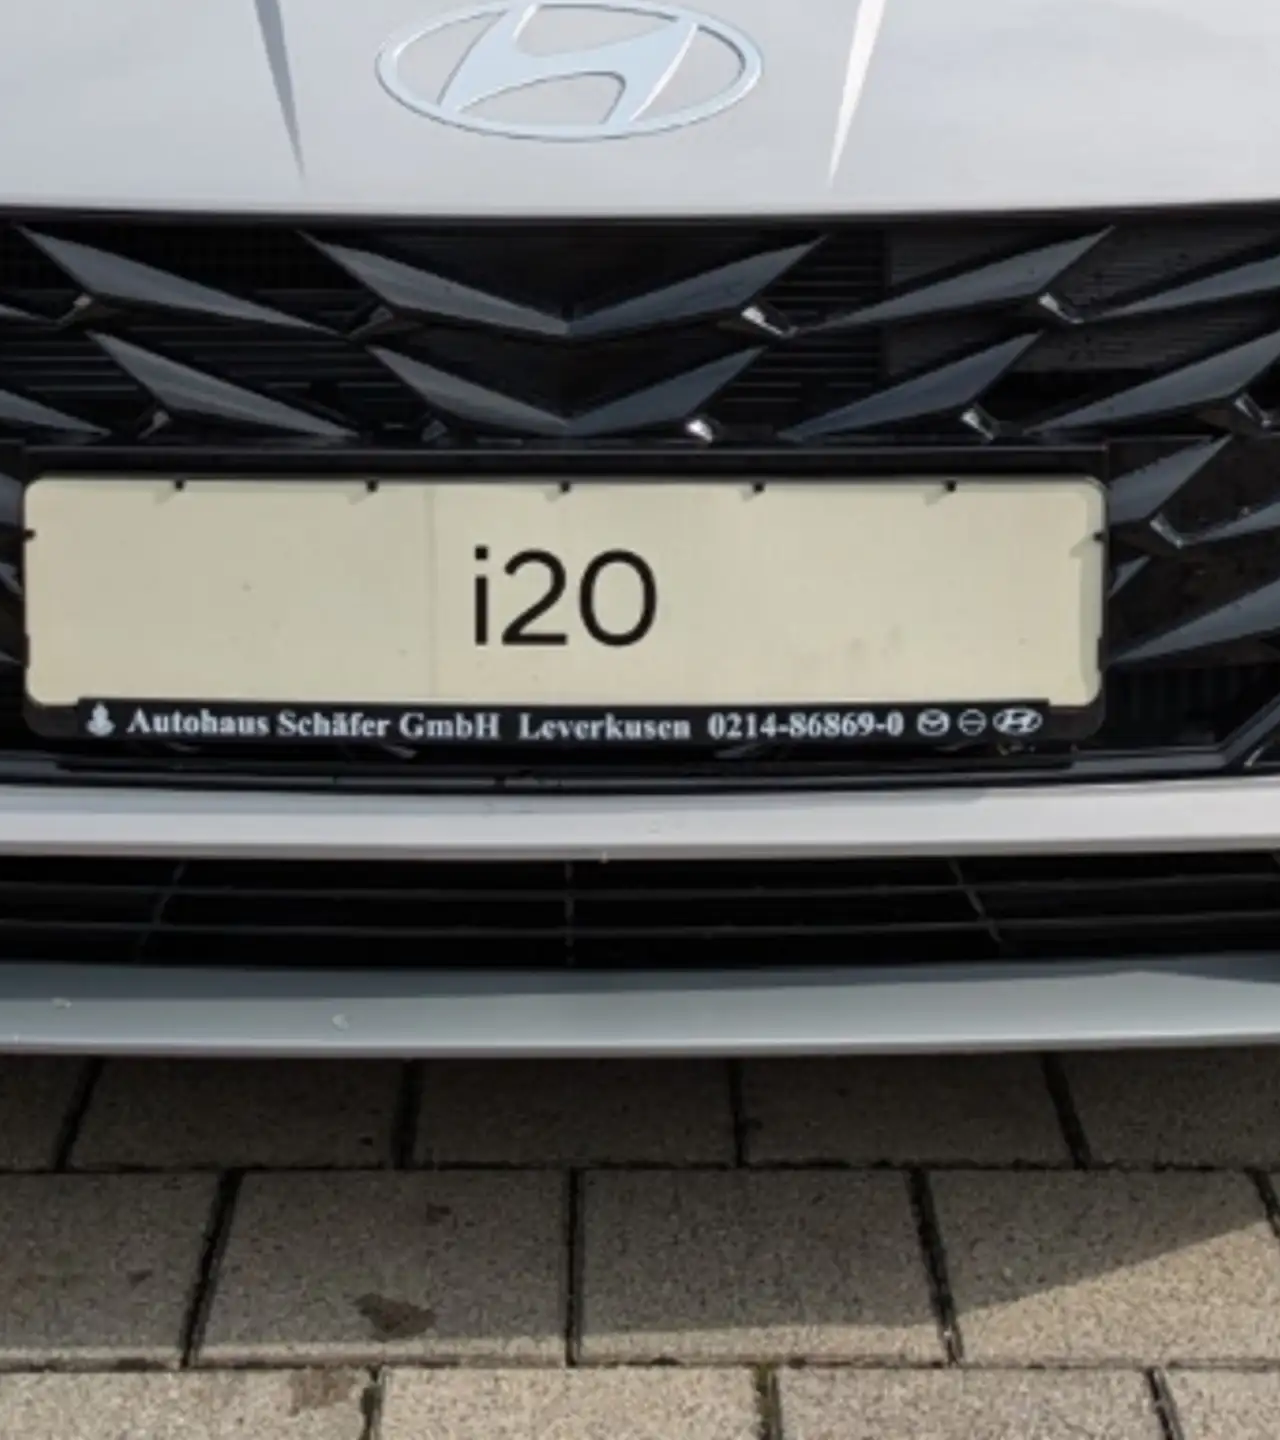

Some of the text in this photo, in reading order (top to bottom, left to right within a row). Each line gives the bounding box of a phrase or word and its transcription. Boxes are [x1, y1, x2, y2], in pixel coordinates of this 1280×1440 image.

[473, 544, 658, 648] i20
[127, 707, 904, 741] Autohaus Schäfer GmbH Leverkusen 0214-86869-0
